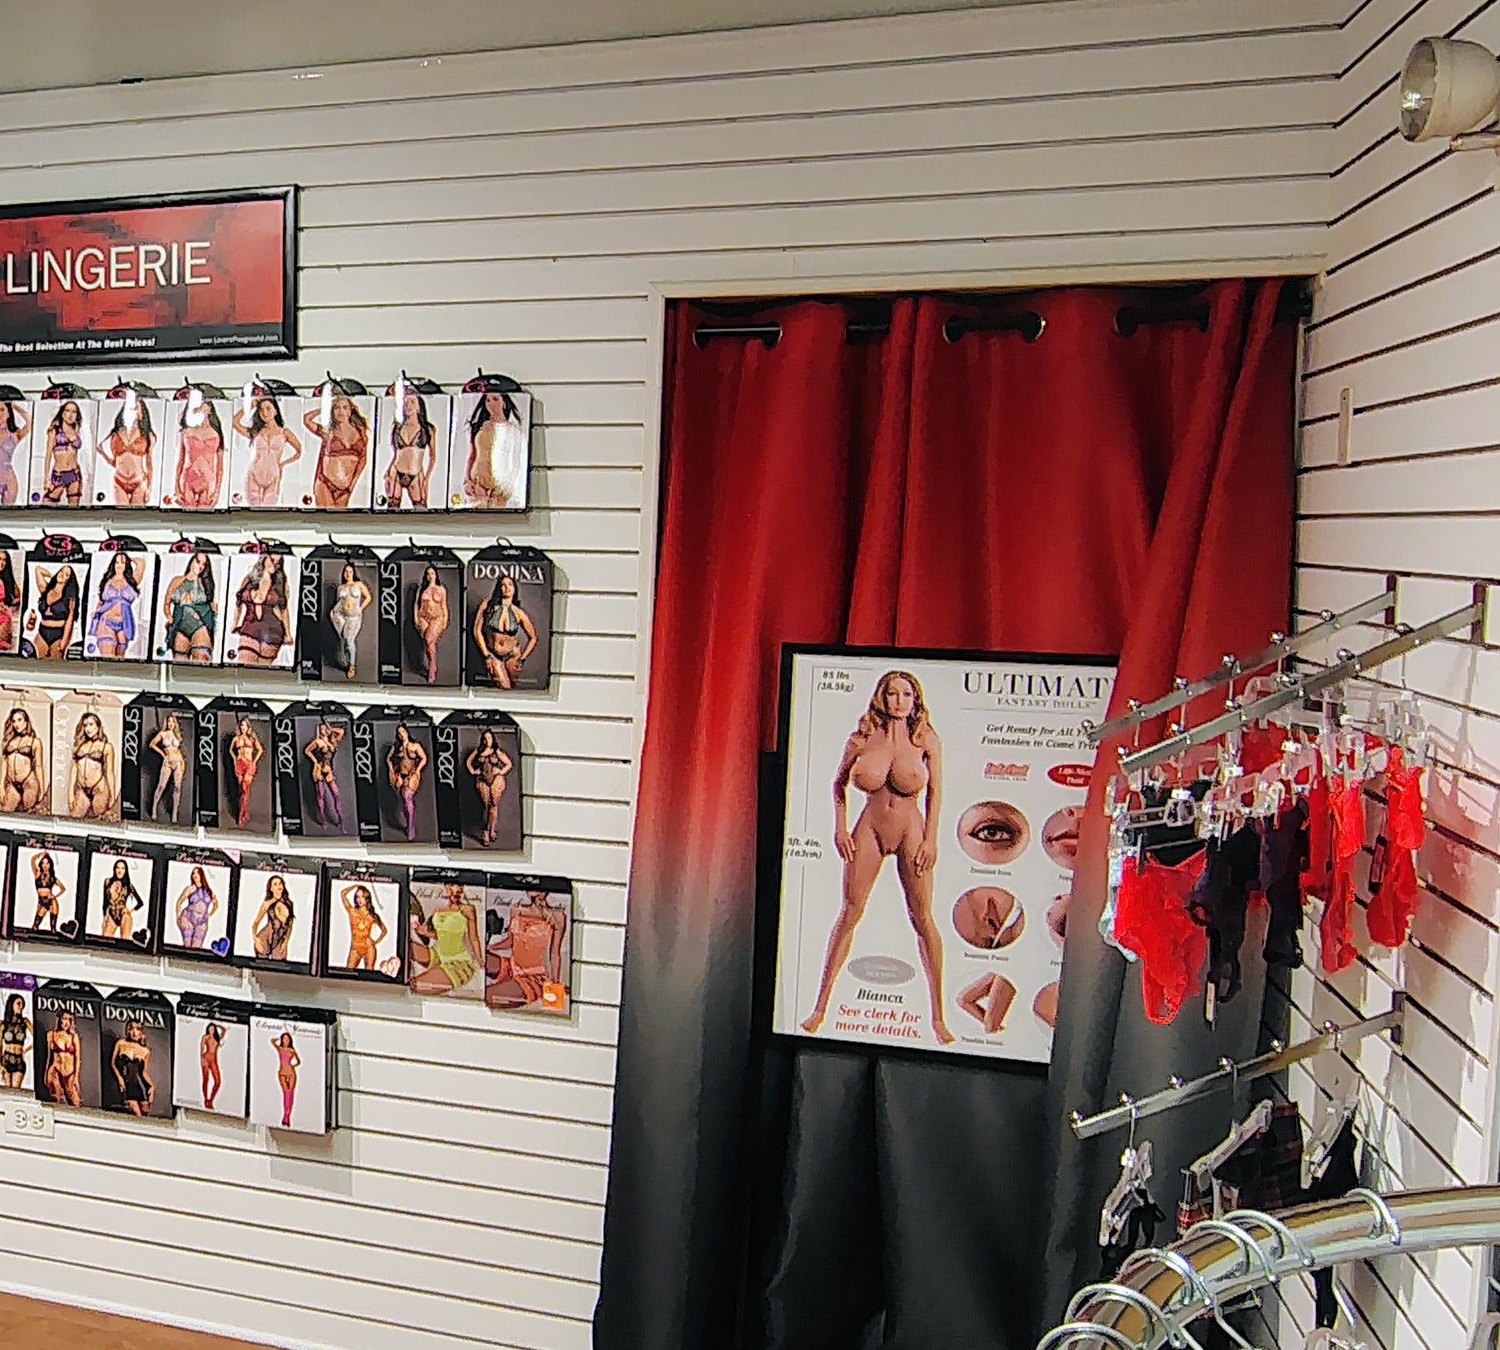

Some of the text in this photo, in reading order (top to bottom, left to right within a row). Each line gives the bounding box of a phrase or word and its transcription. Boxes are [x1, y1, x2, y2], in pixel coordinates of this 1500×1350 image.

[5, 240, 212, 295] LINGERIE
[14, 343, 34, 352] Best
[35, 341, 74, 352] Selection
[75, 340, 86, 350] At
[87, 339, 102, 349] The
[103, 338, 124, 349] Best
[125, 337, 156, 348] Prices!
[474, 562, 544, 585] DOMINA
[962, 671, 1110, 698] ULTIMAT
[997, 697, 1049, 708] FANTASY
[986, 723, 1004, 734] Get
[1006, 724, 1038, 736] Ready
[1039, 725, 1054, 736] for
[1056, 727, 1074, 737] All
[980, 736, 1096, 750] Fantasies to Come Tru
[855, 988, 904, 1004] Bianca
[37, 996, 95, 1018] DOMINA
[105, 1005, 165, 1028] DOMINA
[838, 1004, 922, 1025] See clerk for
[835, 1021, 921, 1038] more details.
